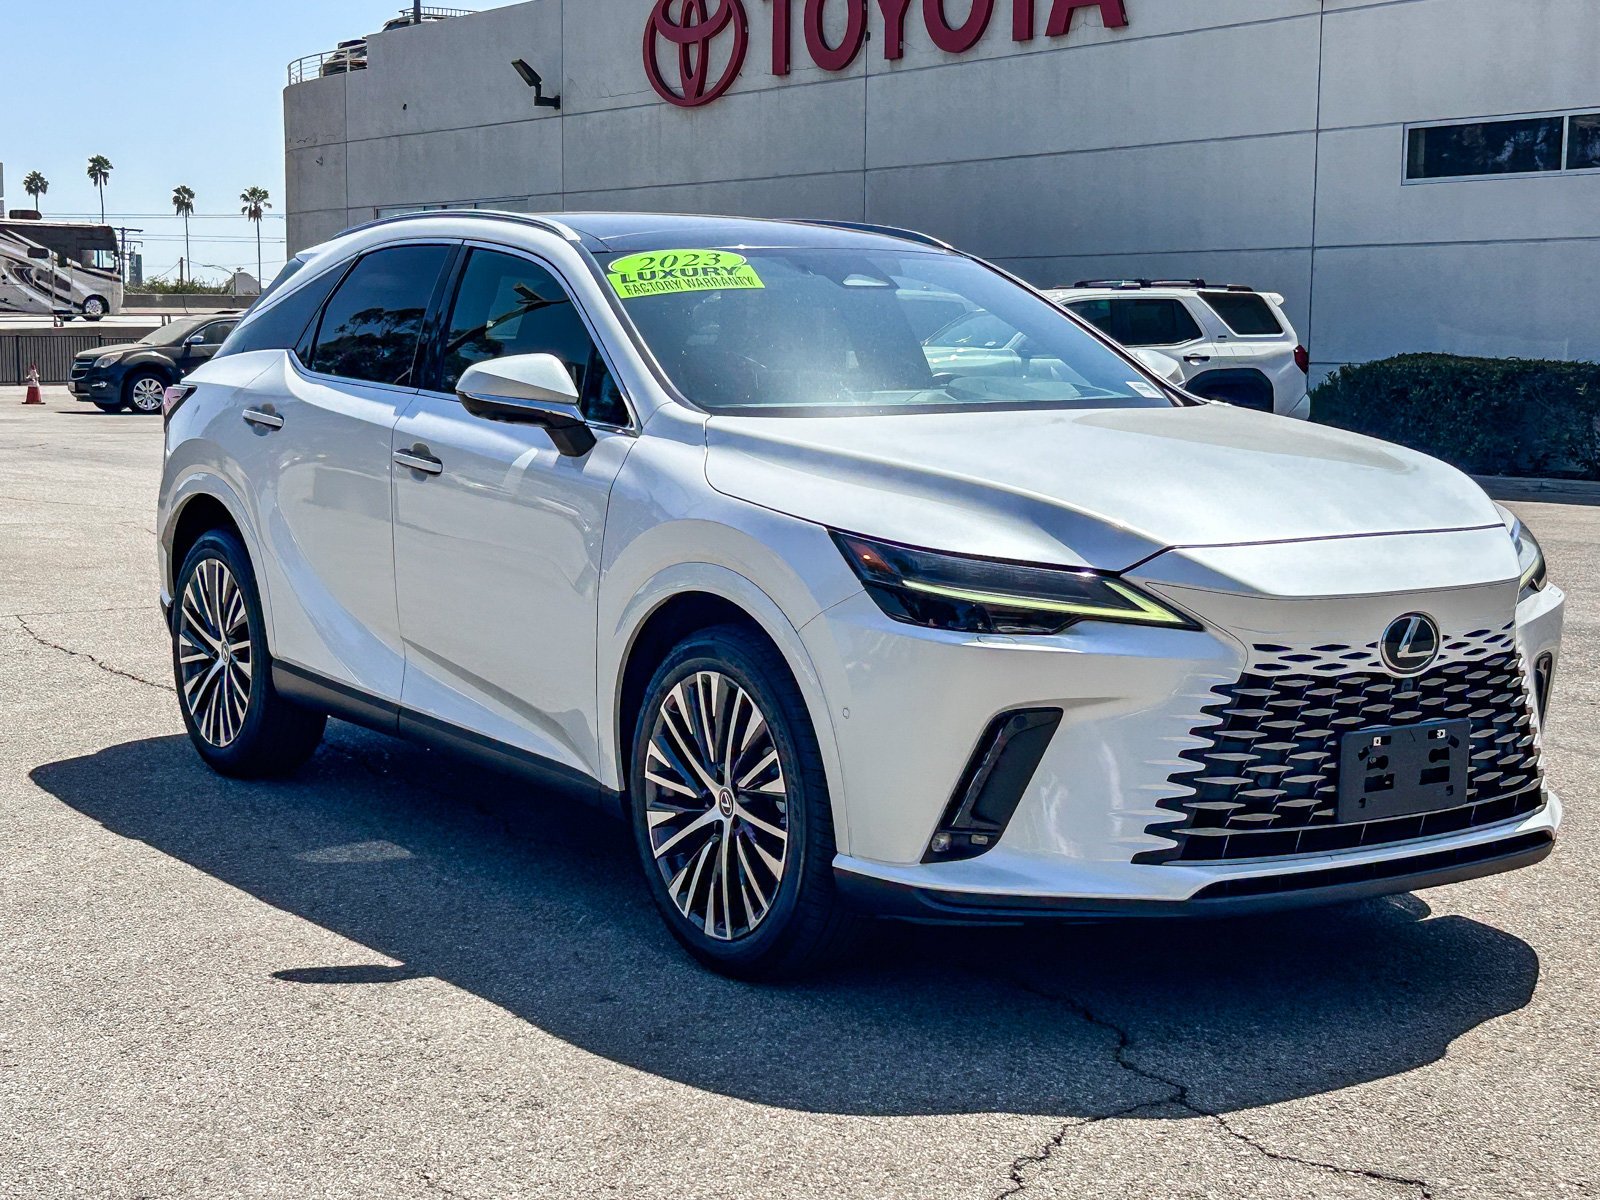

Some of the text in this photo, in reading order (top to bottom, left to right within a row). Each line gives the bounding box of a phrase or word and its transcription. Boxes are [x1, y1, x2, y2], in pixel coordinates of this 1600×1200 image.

[639, 253, 721, 270] 2023
[620, 266, 741, 284] LUXURY
[624, 276, 755, 296] FACTORY WARRANTY
